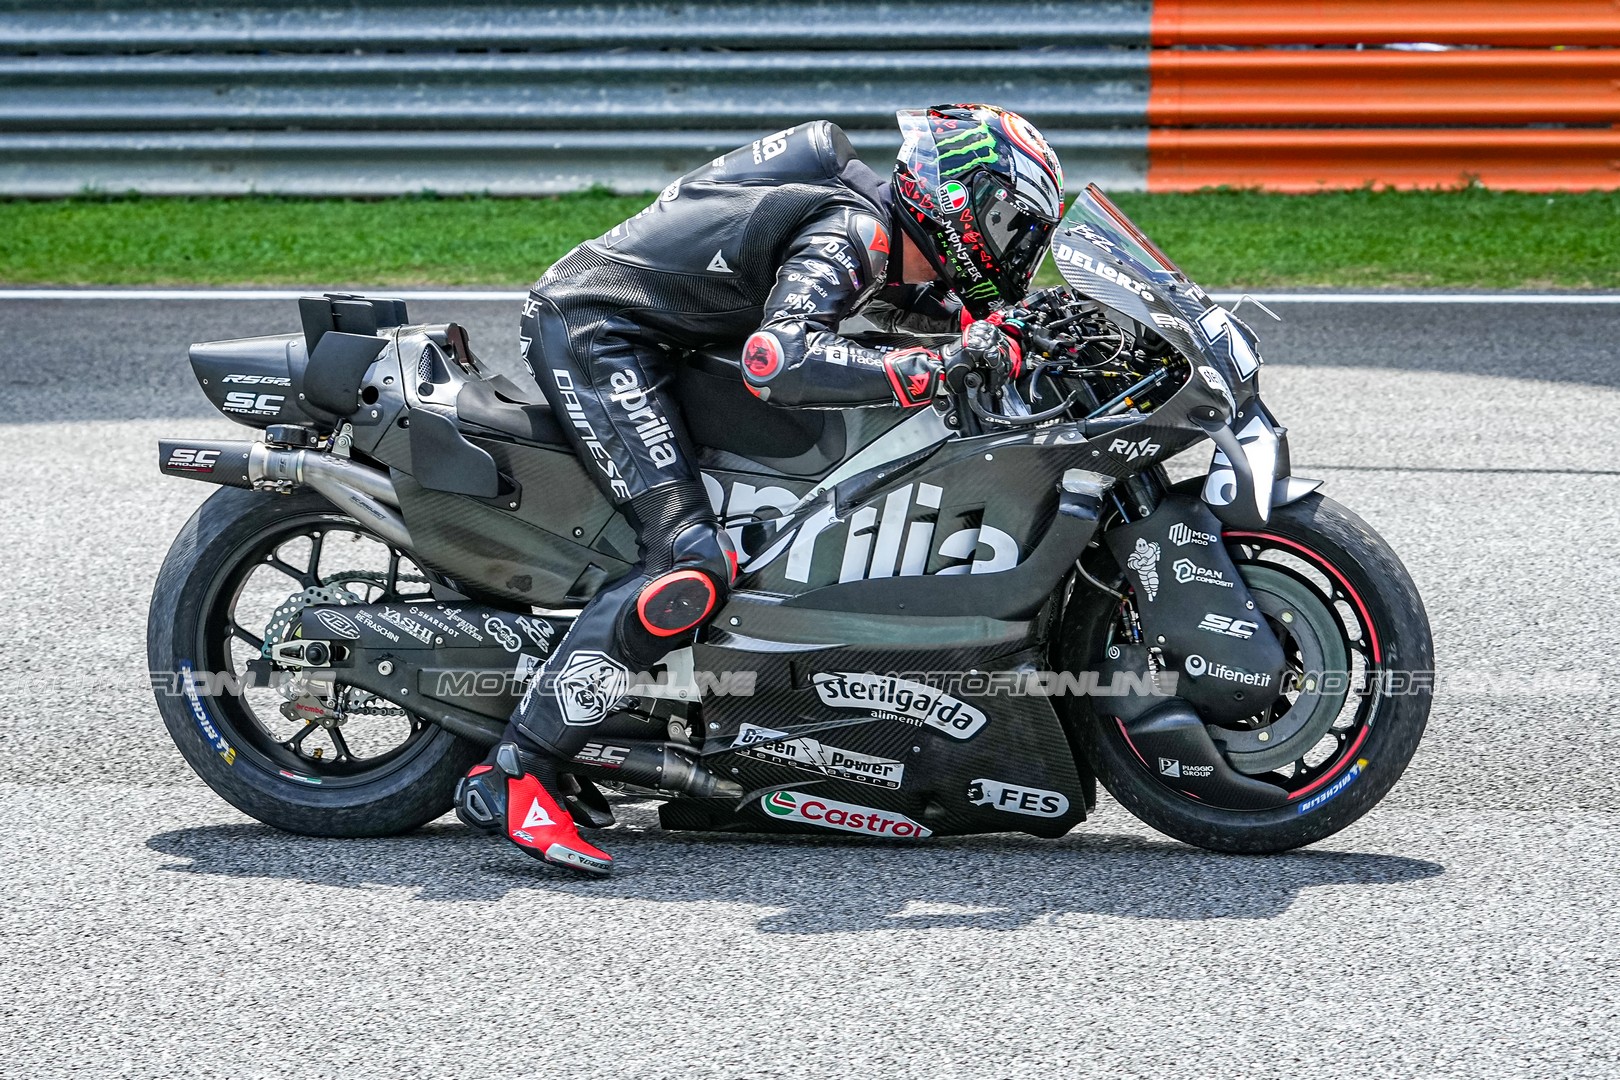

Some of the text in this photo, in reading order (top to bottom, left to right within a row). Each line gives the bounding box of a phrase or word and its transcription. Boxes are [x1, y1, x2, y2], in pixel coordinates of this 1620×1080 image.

[222, 406, 280, 416] PROJECT
[223, 391, 285, 411] SC
[608, 368, 678, 470] aprilia
[552, 368, 633, 500] DAINESE
[169, 448, 222, 465] SC
[1191, 538, 1209, 546] MOD
[1192, 530, 1218, 543] MOD
[1196, 567, 1223, 580] PAN
[384, 606, 435, 640] YASHI
[417, 611, 460, 638] SHAREBOT
[1199, 613, 1259, 636] SC
[1208, 661, 1272, 687] Lifenet.it
[295, 703, 325, 715] brembo
[823, 676, 974, 731] sterilgarda
[870, 709, 925, 728] alimenti
[578, 742, 631, 761] SC
[741, 728, 894, 777] Green Power
[1182, 764, 1214, 773] PIAGGIO
[998, 788, 1061, 815] FES
[1302, 773, 1351, 812] MICHELIN
[799, 800, 924, 838] Castrol
